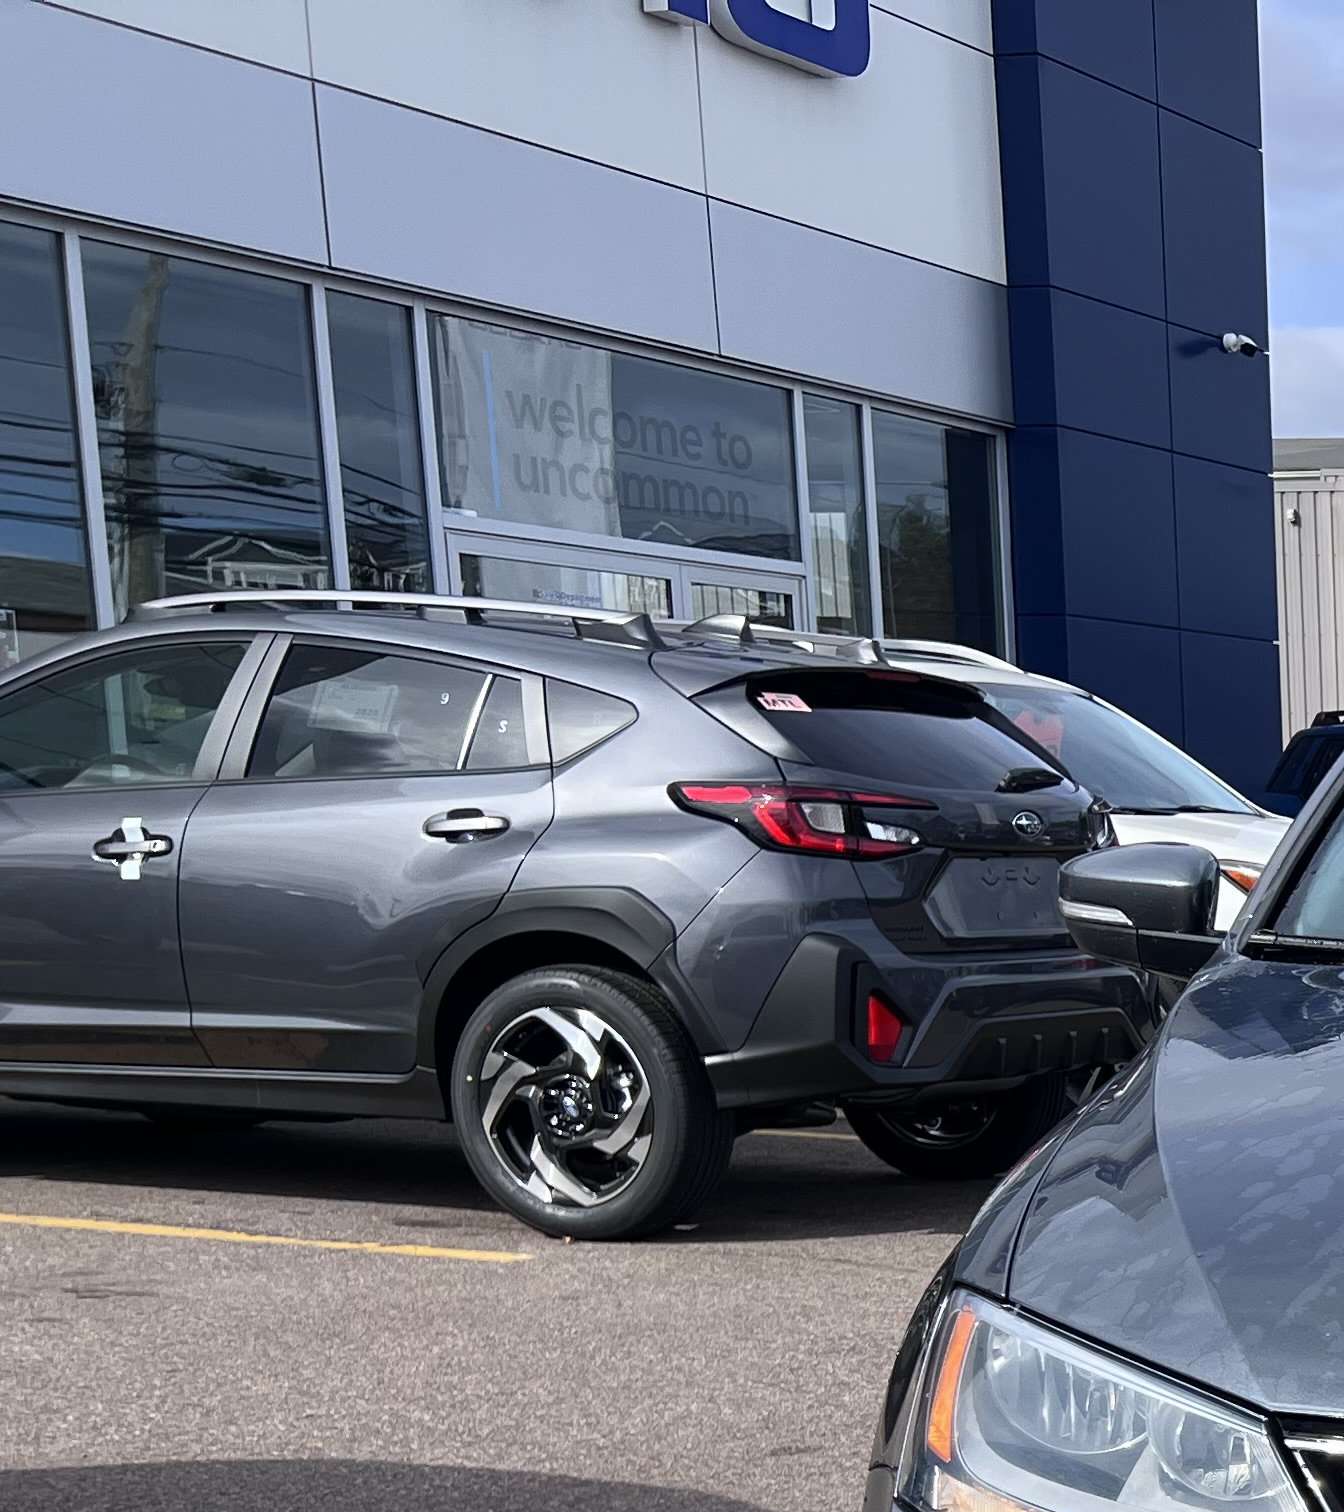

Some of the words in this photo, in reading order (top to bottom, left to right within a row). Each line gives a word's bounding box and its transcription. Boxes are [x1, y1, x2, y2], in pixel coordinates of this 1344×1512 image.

[504, 384, 703, 462] welcome
[712, 421, 753, 470] to
[512, 453, 751, 526] uncommon
